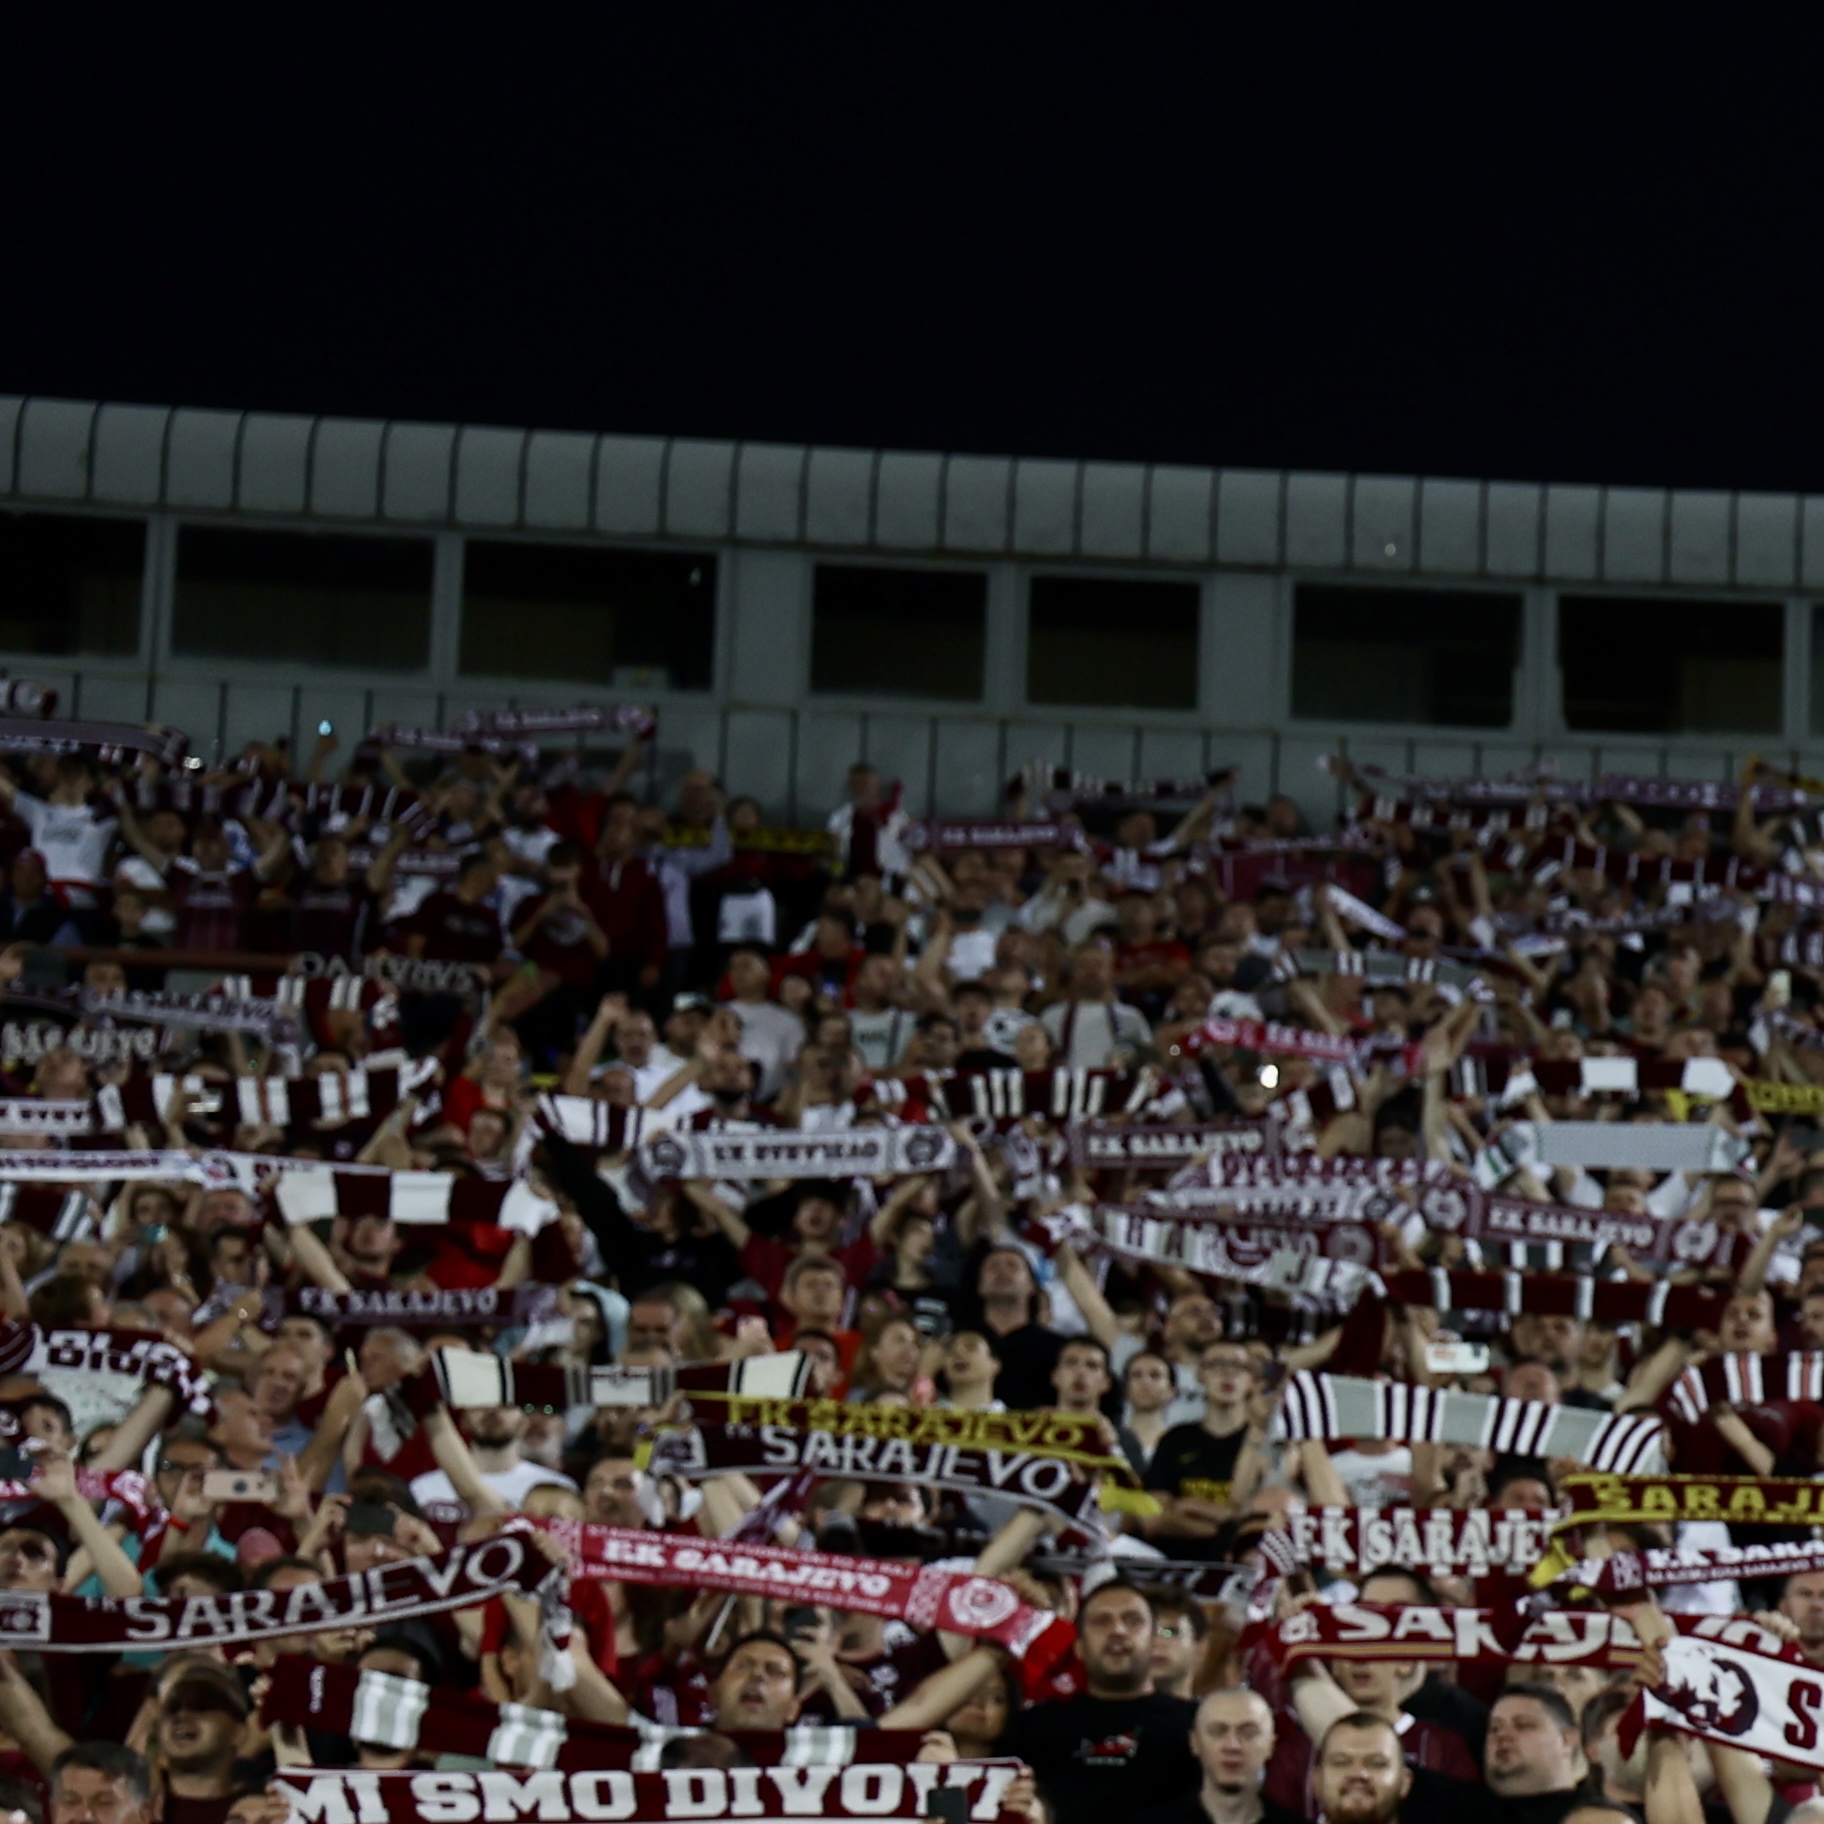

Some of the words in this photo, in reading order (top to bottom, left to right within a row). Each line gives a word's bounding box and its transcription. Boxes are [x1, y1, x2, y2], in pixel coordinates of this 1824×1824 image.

[760, 1424, 1072, 1500] SARAJEVO
[124, 1536, 527, 1643] SARAJEVO
[413, 1768, 638, 1824] SMO
